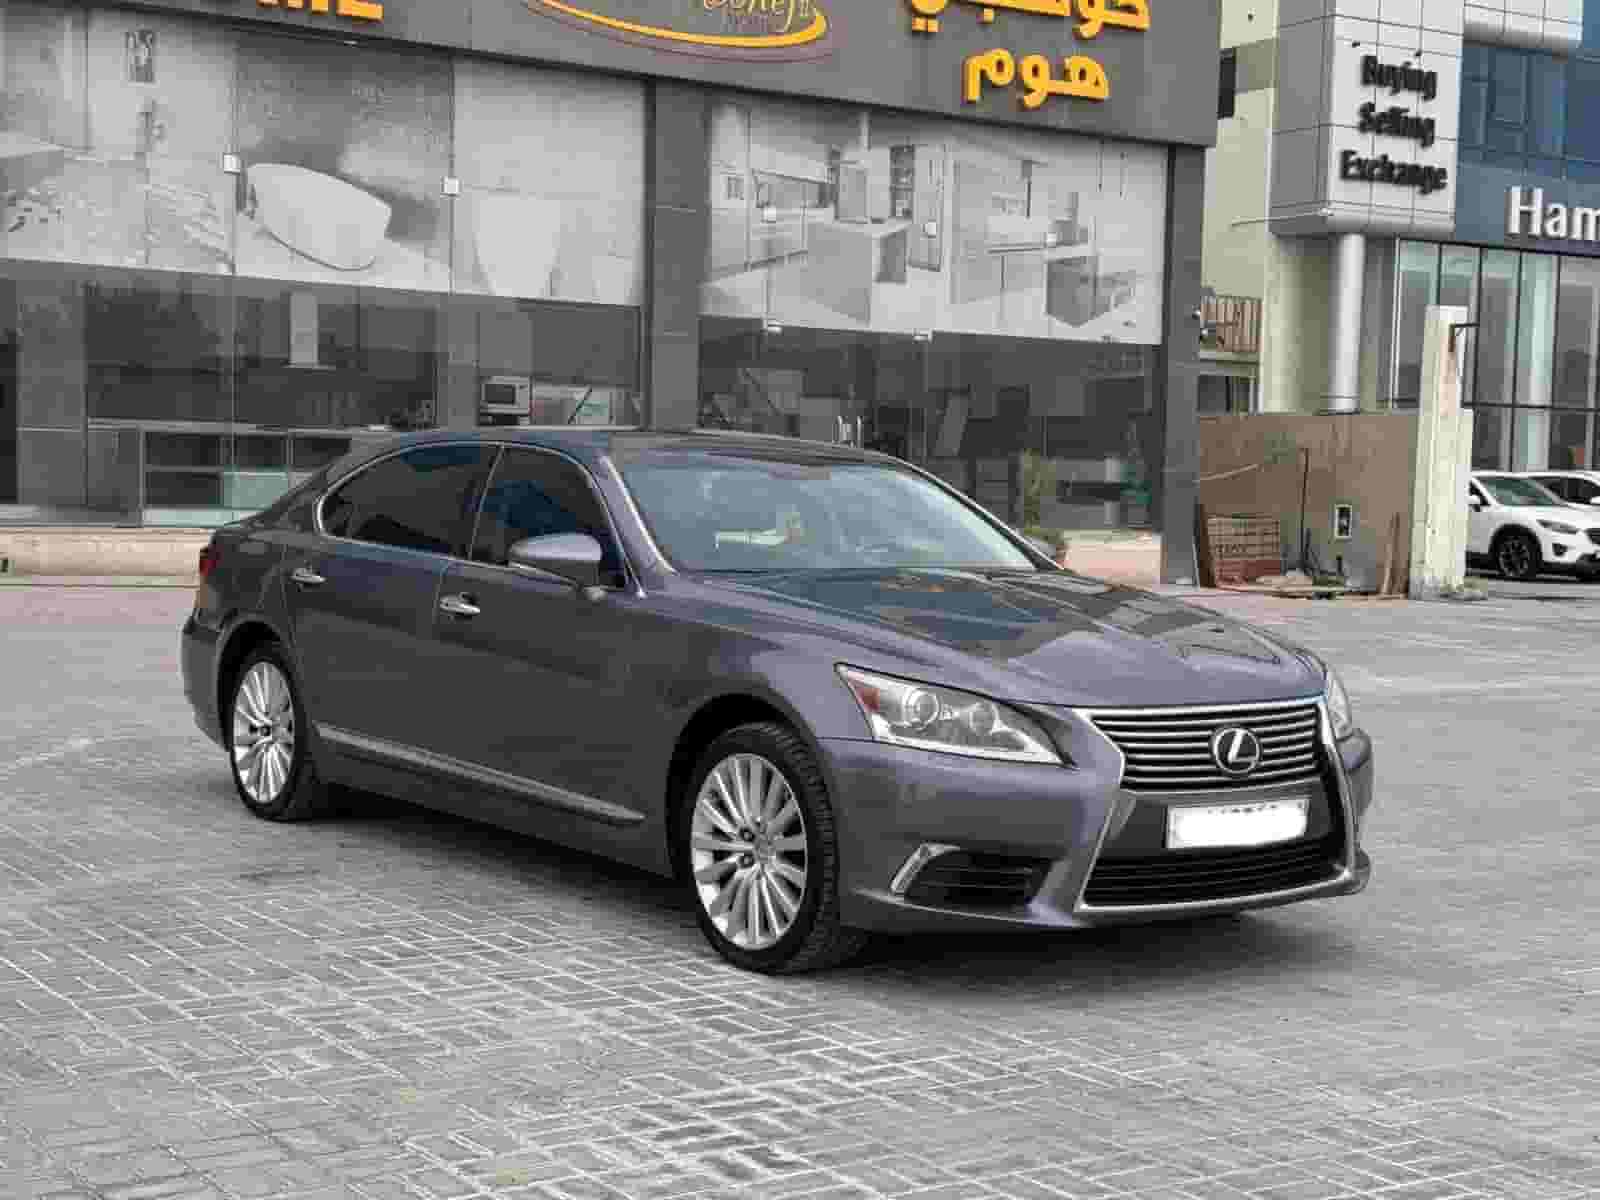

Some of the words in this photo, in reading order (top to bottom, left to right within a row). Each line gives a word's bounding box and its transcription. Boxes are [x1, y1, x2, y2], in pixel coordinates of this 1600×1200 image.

[963, 50, 1109, 108] هوم
[1361, 56, 1438, 102] Buying
[1359, 102, 1435, 147] Selling
[1340, 149, 1448, 195] Exchange
